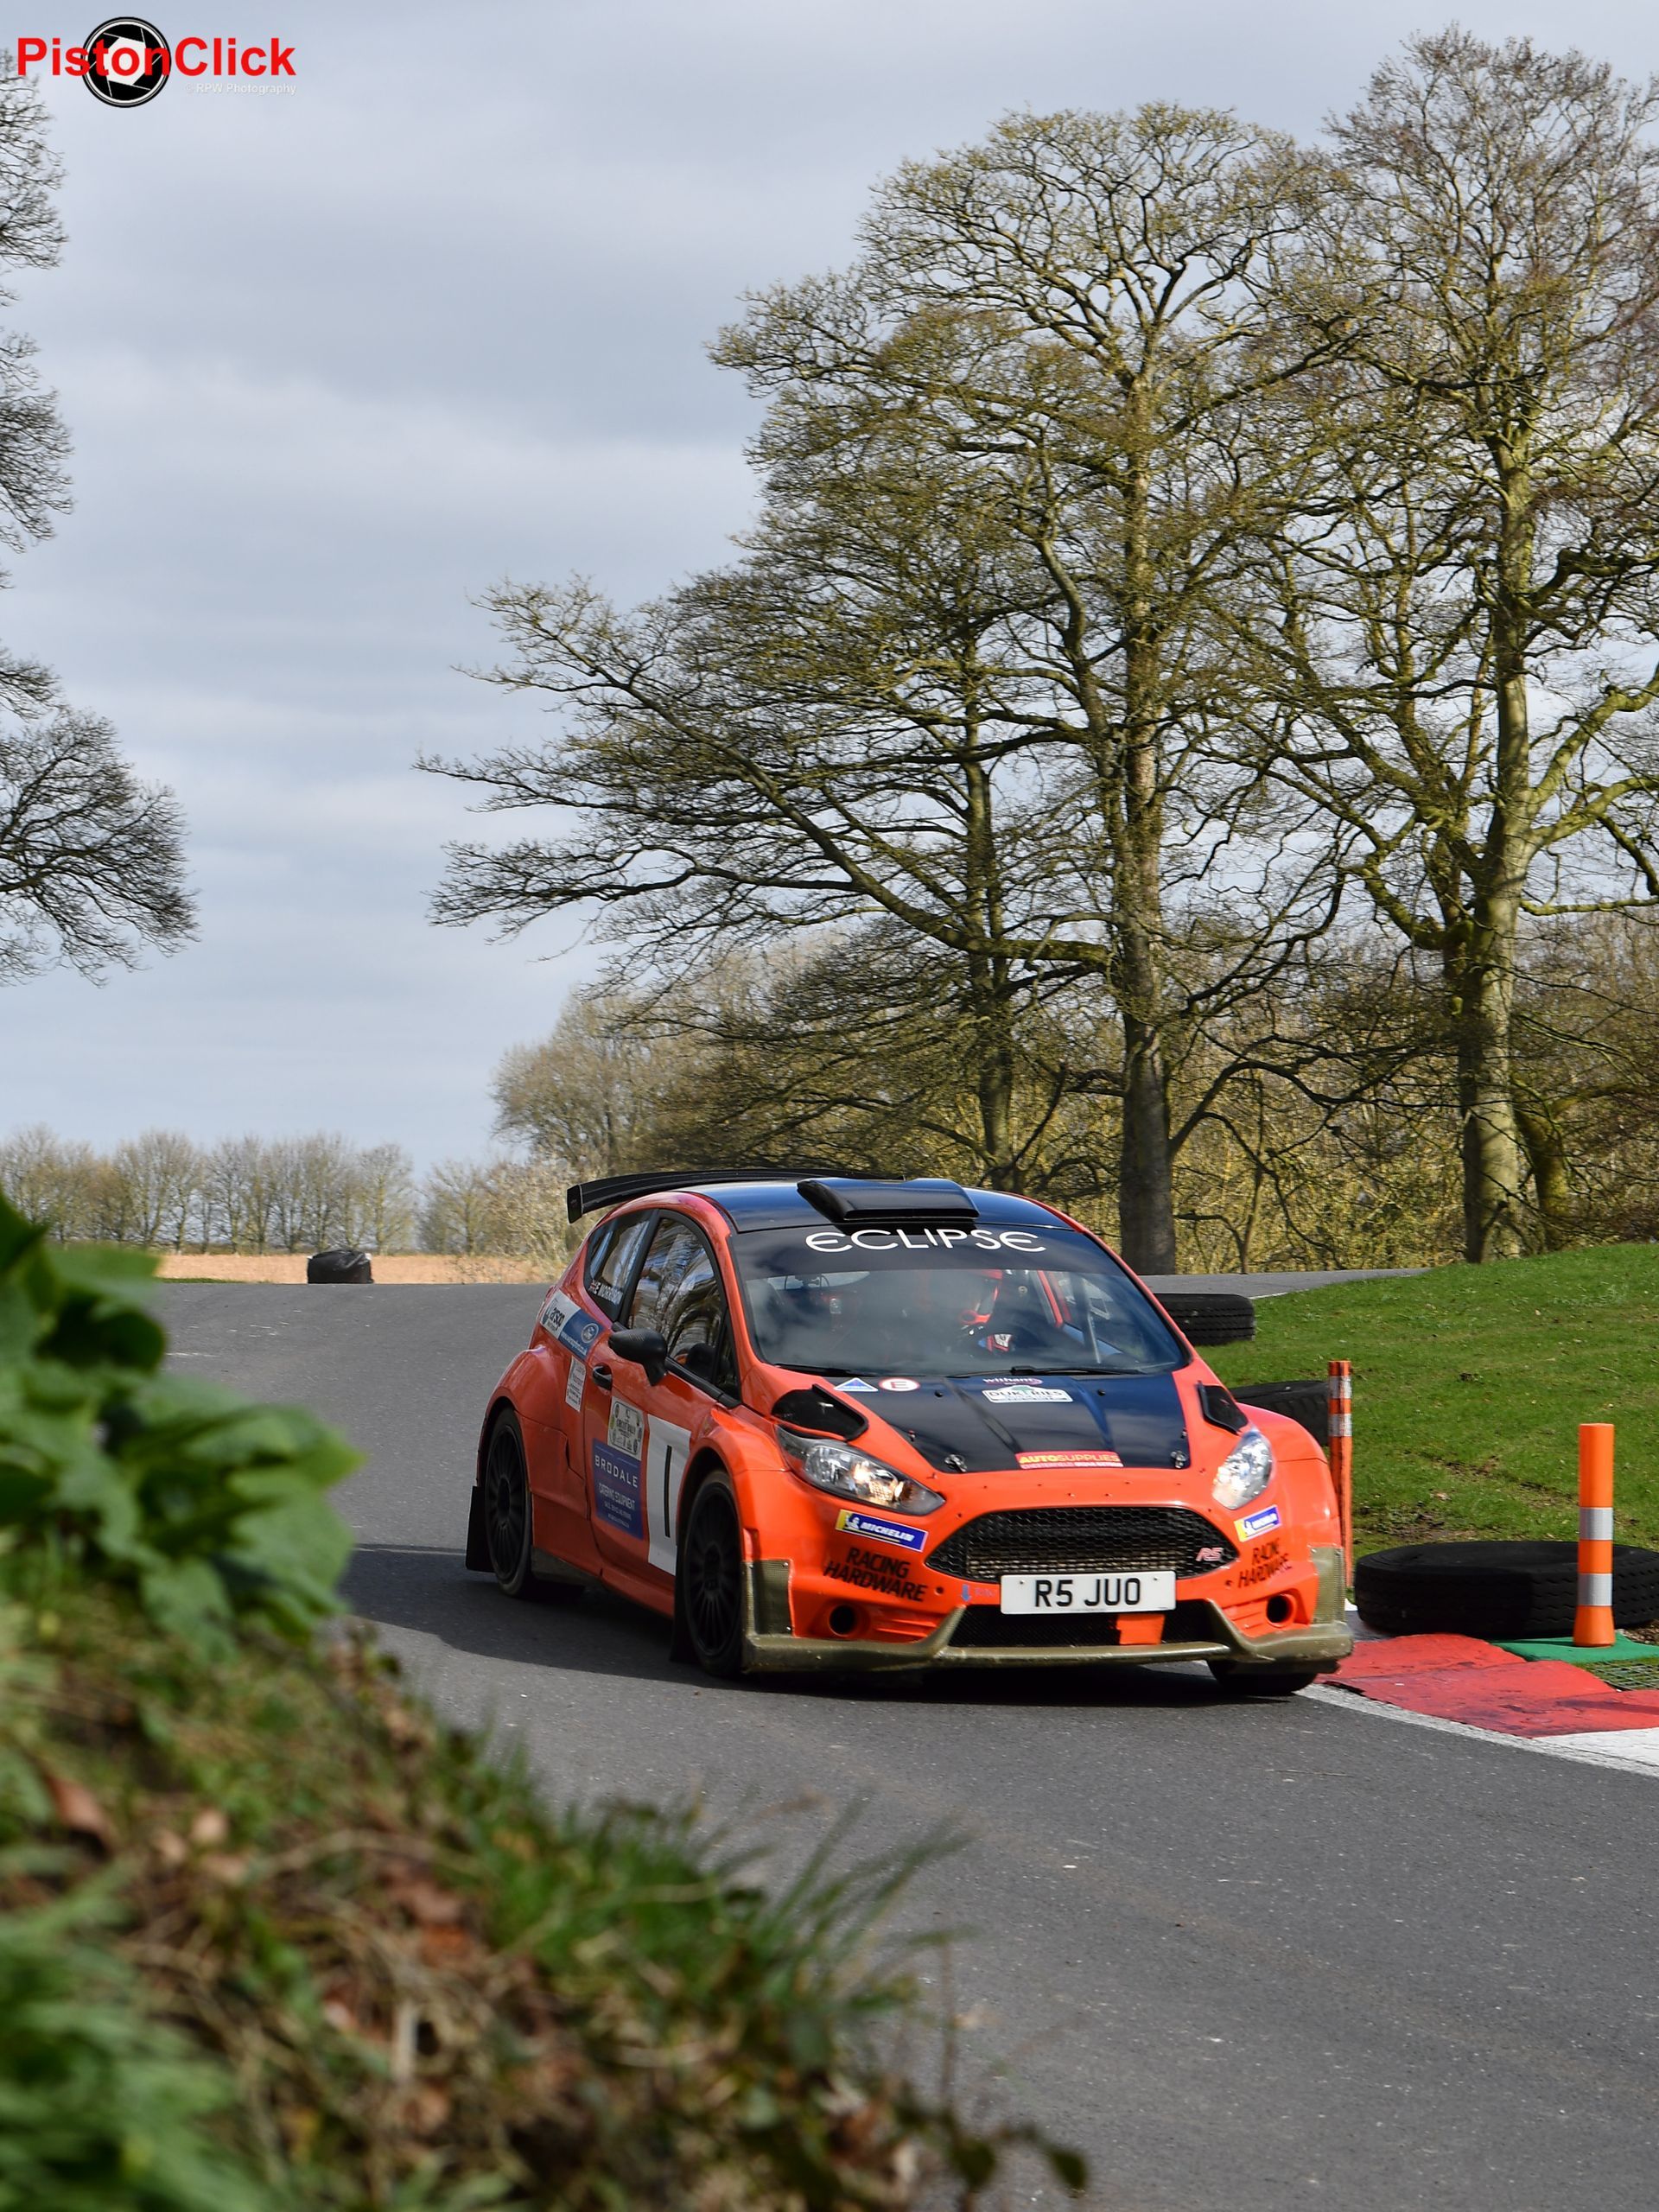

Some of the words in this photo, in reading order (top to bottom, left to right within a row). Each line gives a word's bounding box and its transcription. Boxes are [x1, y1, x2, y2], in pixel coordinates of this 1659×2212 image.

[805, 1228, 1046, 1253] ECLIPSE
[594, 1455, 638, 1488] BRODALE
[861, 1522, 915, 1542] MICHELIN
[846, 1547, 911, 1579] RACING
[1196, 1548, 1224, 1562] RS
[823, 1560, 928, 1603] HARDWARE
[1035, 1580, 1073, 1608] R5
[1084, 1578, 1141, 1606] JUO
